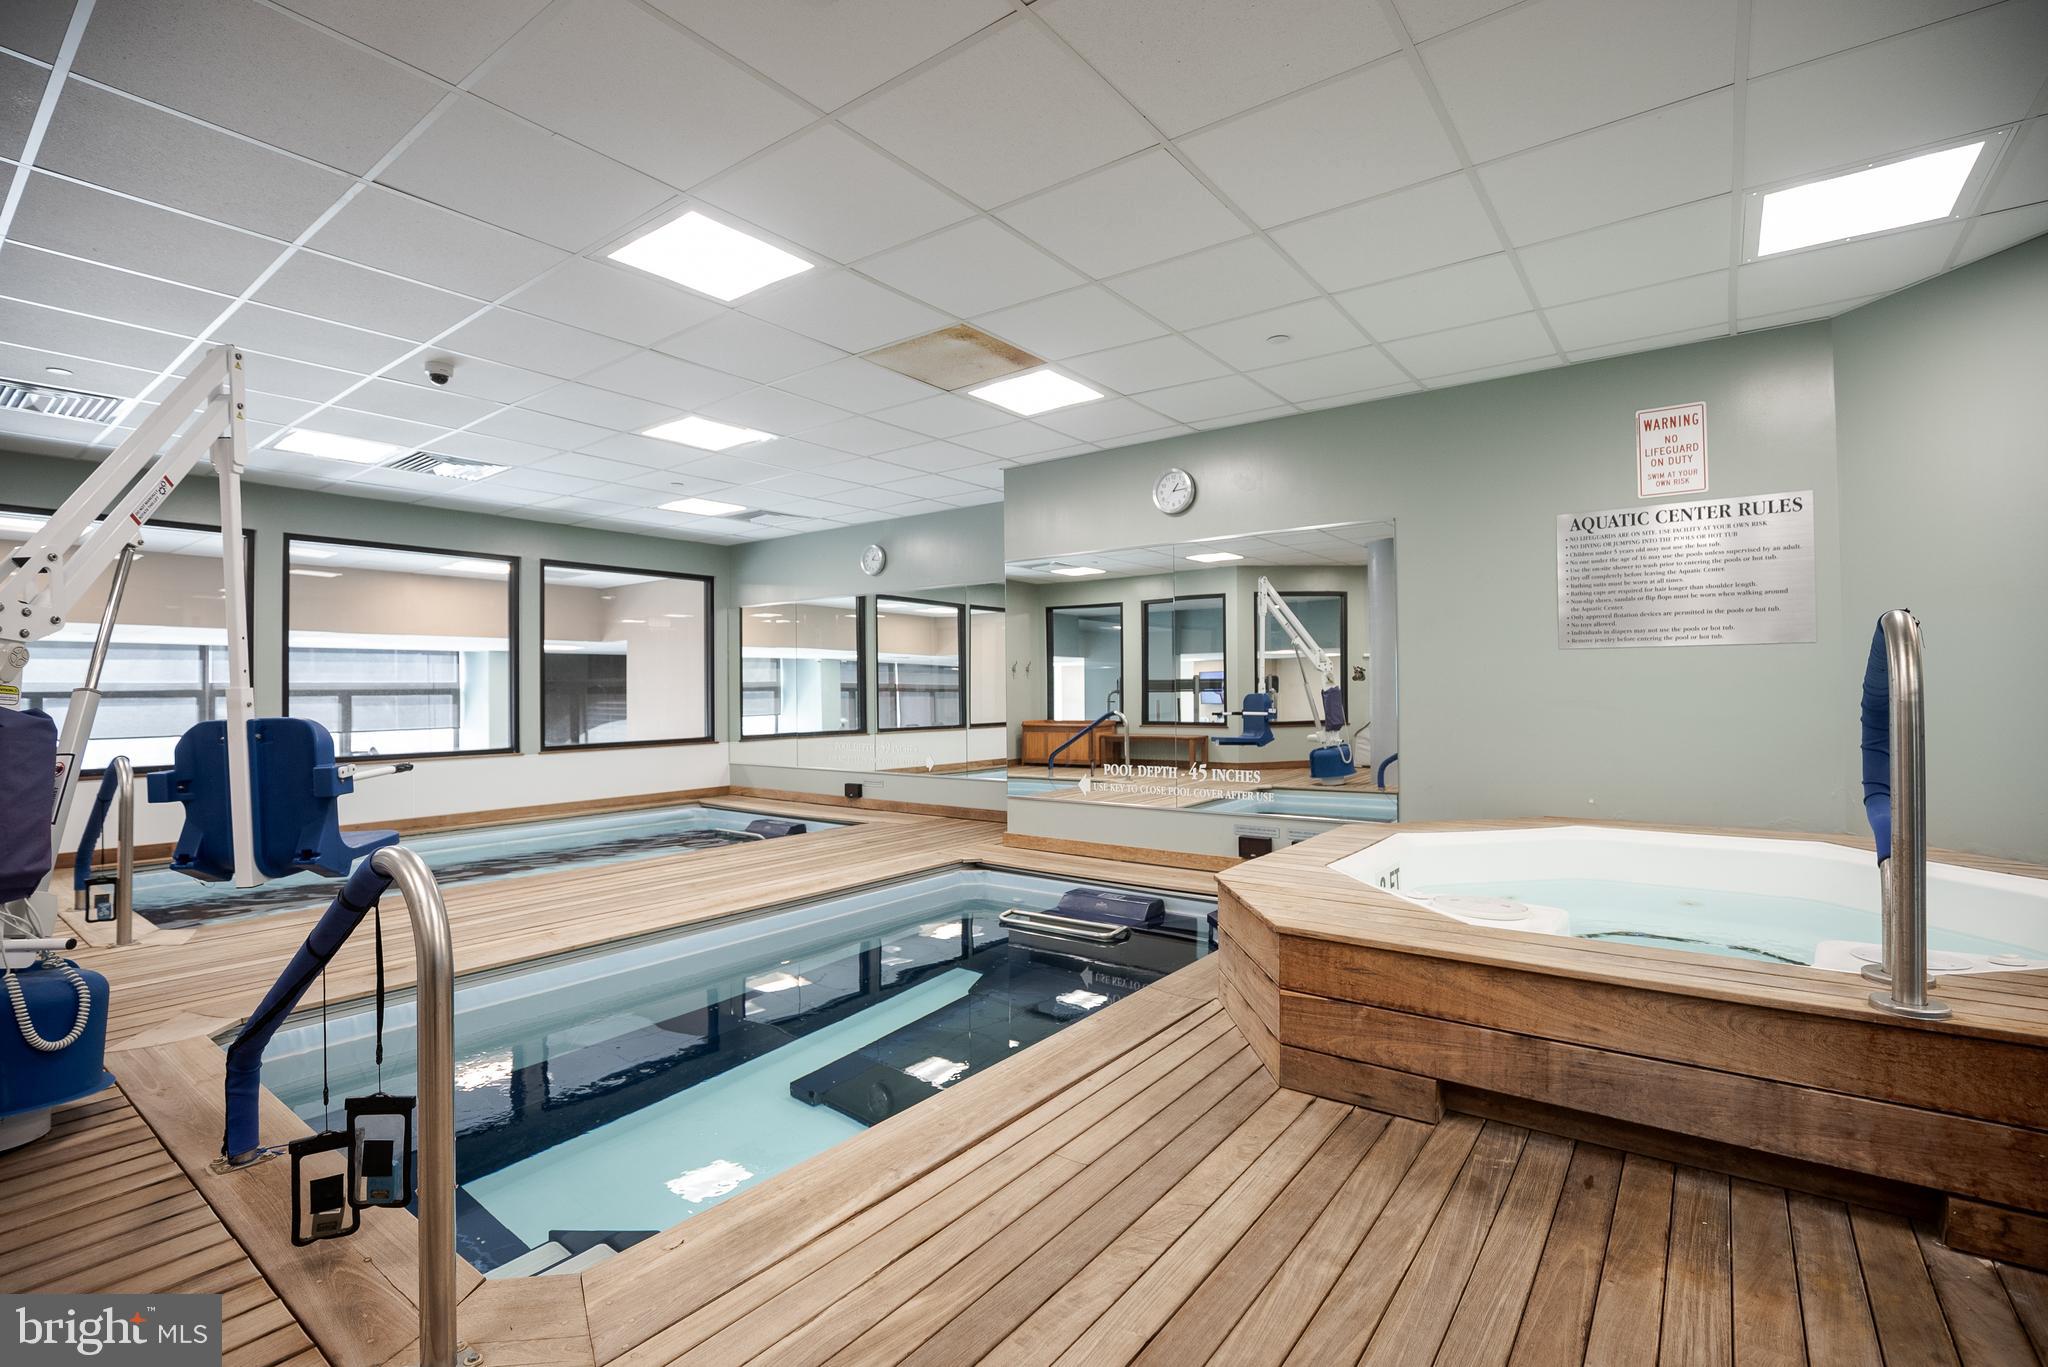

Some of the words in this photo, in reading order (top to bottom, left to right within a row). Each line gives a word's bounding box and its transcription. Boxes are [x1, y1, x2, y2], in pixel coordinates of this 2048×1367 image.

[1644, 412, 1699, 432] WARNING
[1664, 434, 1678, 444] NO
[1645, 442, 1699, 457] LIFEGUARD
[1651, 458, 1664, 468] ON
[1668, 454, 1693, 466] DUTY
[1648, 472, 1665, 480] SWIM
[1679, 468, 1698, 476] YOUR
[1656, 480, 1671, 488] OWN
[1674, 477, 1690, 486] RISK
[1570, 511, 1649, 533] AQUATIC
[1655, 503, 1731, 524] CENTER
[1738, 496, 1803, 517] RULES
[1104, 763, 1135, 777] POOL
[1137, 764, 1178, 778] DEPTH
[1188, 762, 1208, 782] 45
[1212, 768, 1261, 784] INCHES
[1093, 782, 1108, 792] USE
[1110, 783, 1125, 793] KEY
[1126, 784, 1138, 793] TO
[1140, 784, 1166, 796] CLOSE
[1168, 786, 1191, 797] POOL
[1193, 788, 1223, 799] COVER
[1225, 790, 1254, 801] AFTER
[1256, 792, 1274, 802] USE
